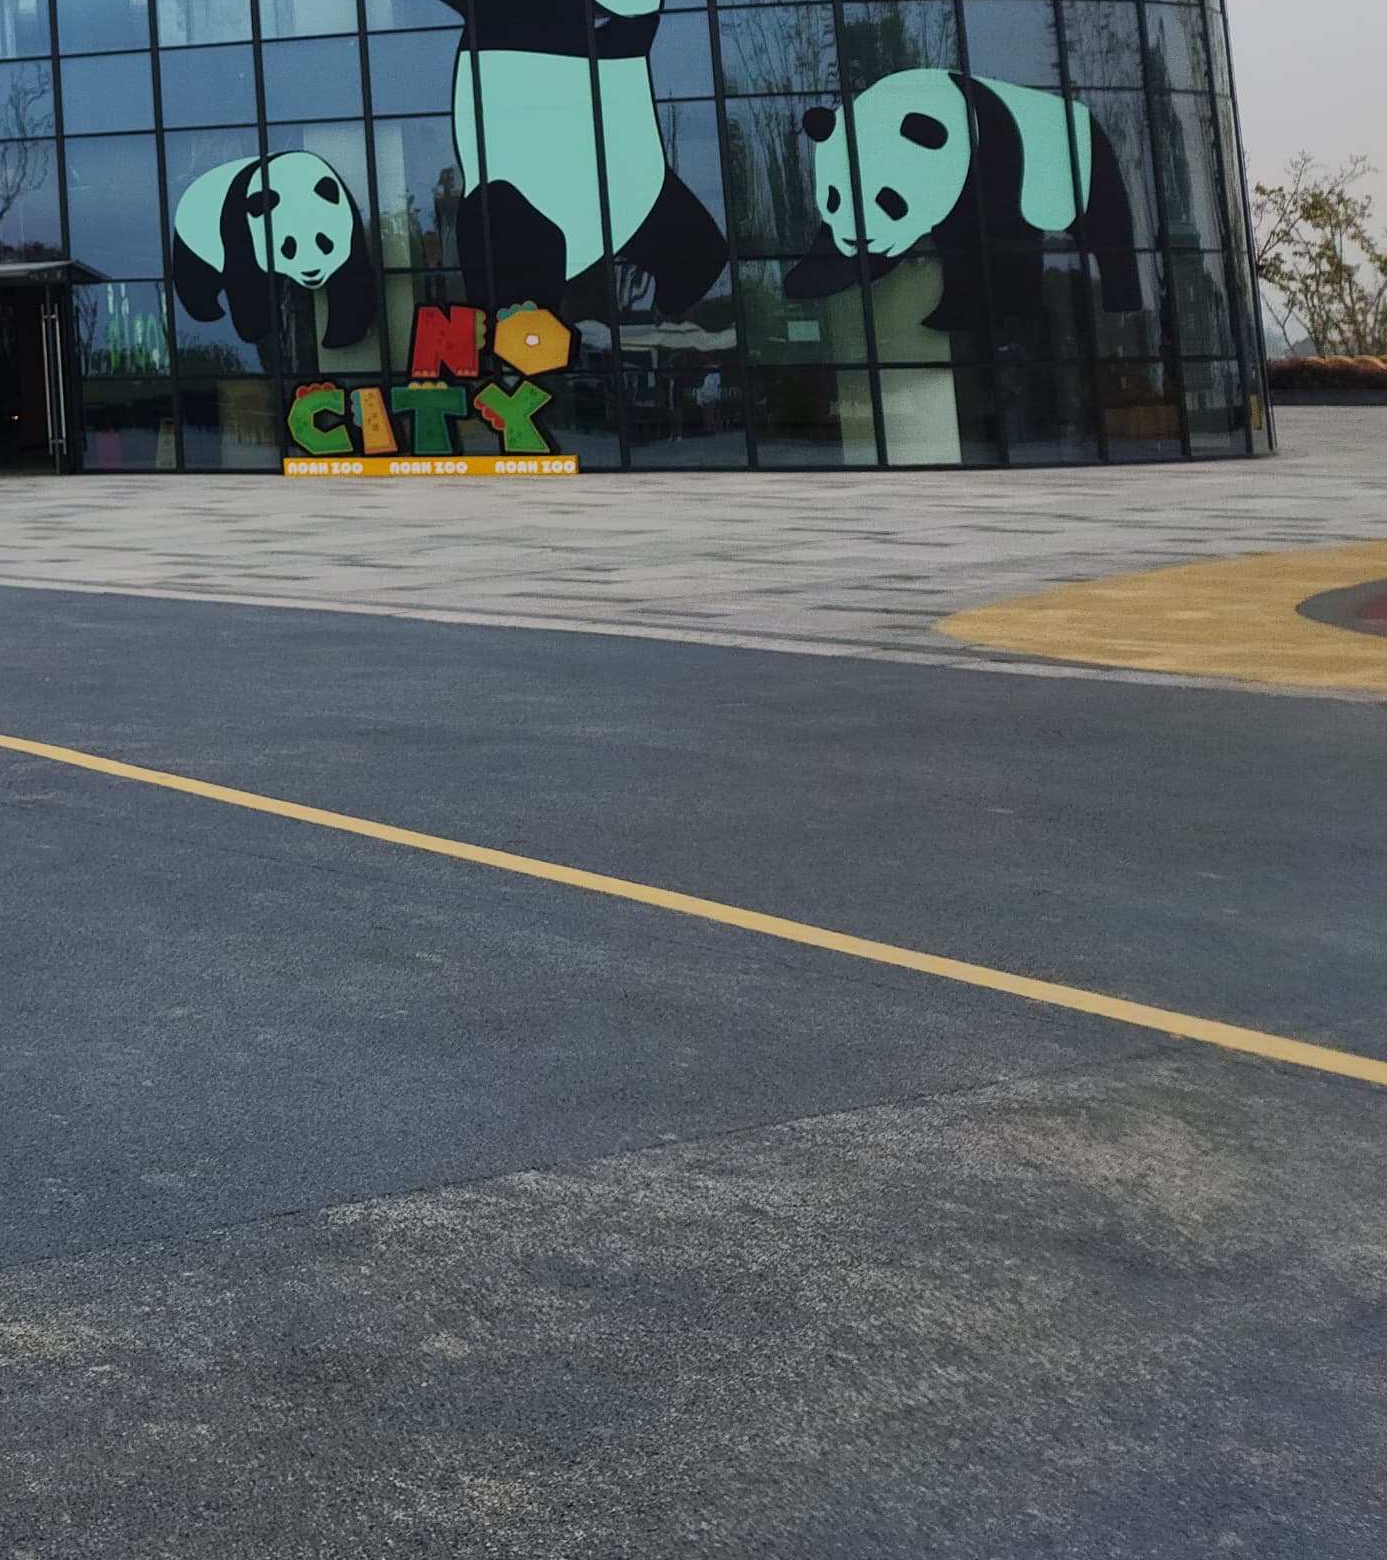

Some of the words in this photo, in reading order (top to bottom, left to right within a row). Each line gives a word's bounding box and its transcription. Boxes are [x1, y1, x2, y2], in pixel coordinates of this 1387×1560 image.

[411, 300, 572, 379] NO
[287, 380, 553, 456] CITY
[331, 461, 364, 474] ZOO
[434, 461, 468, 474] ZOO
[541, 461, 576, 474] ZOO
